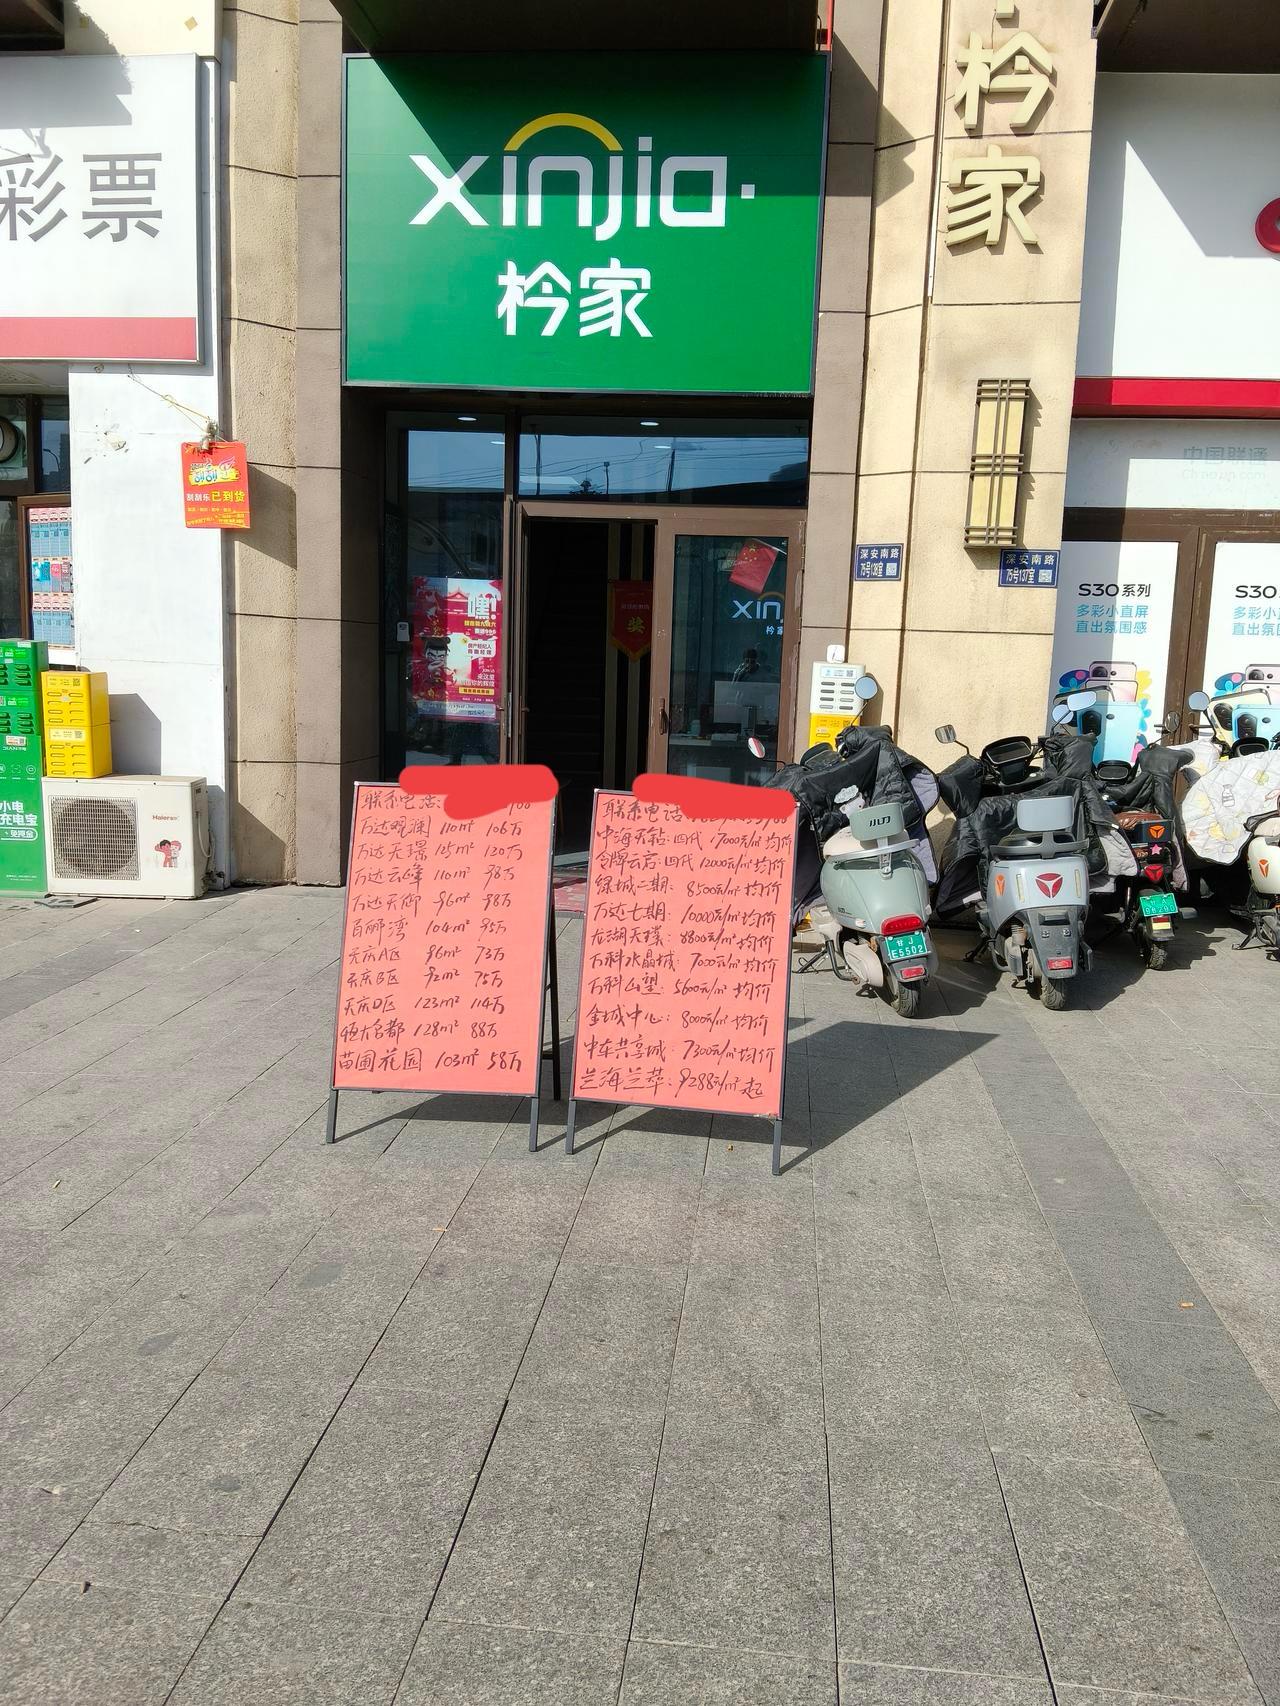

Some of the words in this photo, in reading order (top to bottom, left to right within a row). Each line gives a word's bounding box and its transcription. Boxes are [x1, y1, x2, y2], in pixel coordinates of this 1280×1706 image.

[0, 153, 163, 243] 彩票
[860, 548, 900, 560] 深安南路
[1006, 553, 1055, 566] 深安南路
[1076, 604, 1149, 619] 多彩小直屏
[1075, 621, 1148, 635] 直出氛围感
[1232, 622, 1280, 636] 直出氛
[486, 821, 524, 837] 106万
[484, 844, 523, 861] 120万
[474, 945, 505, 965] 73万
[891, 945, 924, 959] E5502
[474, 970, 504, 988] 75万
[471, 995, 505, 1015] 114万
[471, 1021, 498, 1039] 88万
[487, 1050, 523, 1073] 58万
